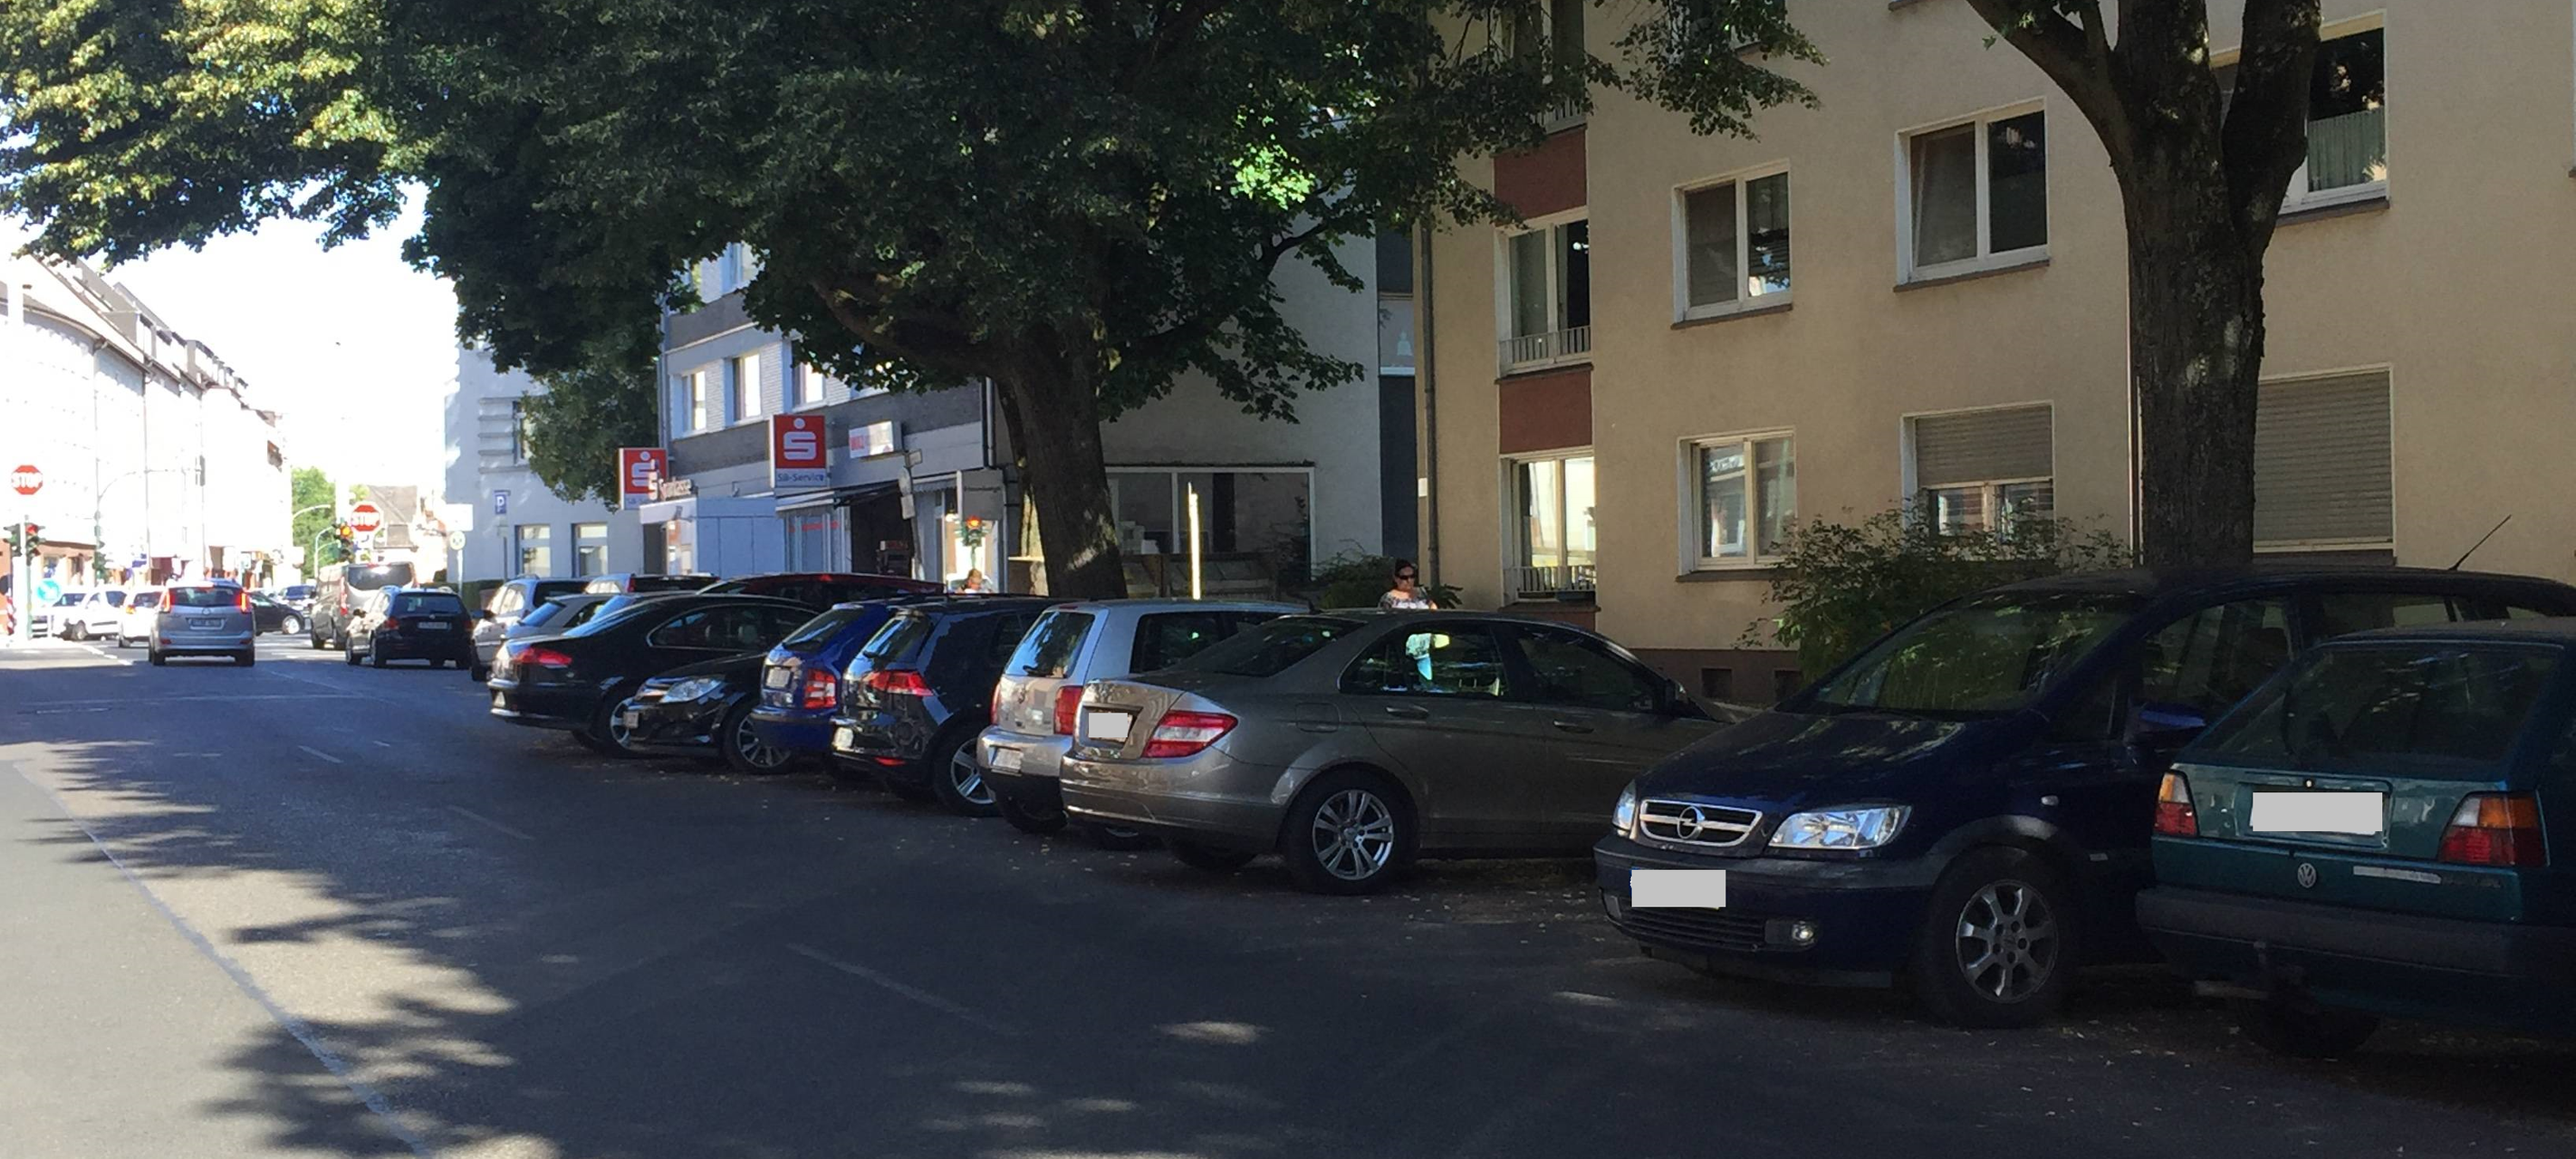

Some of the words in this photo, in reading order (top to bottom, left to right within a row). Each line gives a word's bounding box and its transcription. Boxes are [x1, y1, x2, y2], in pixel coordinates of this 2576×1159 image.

[11, 471, 43, 488] STOP
[496, 495, 505, 512] P
[351, 511, 380, 526] STOP
